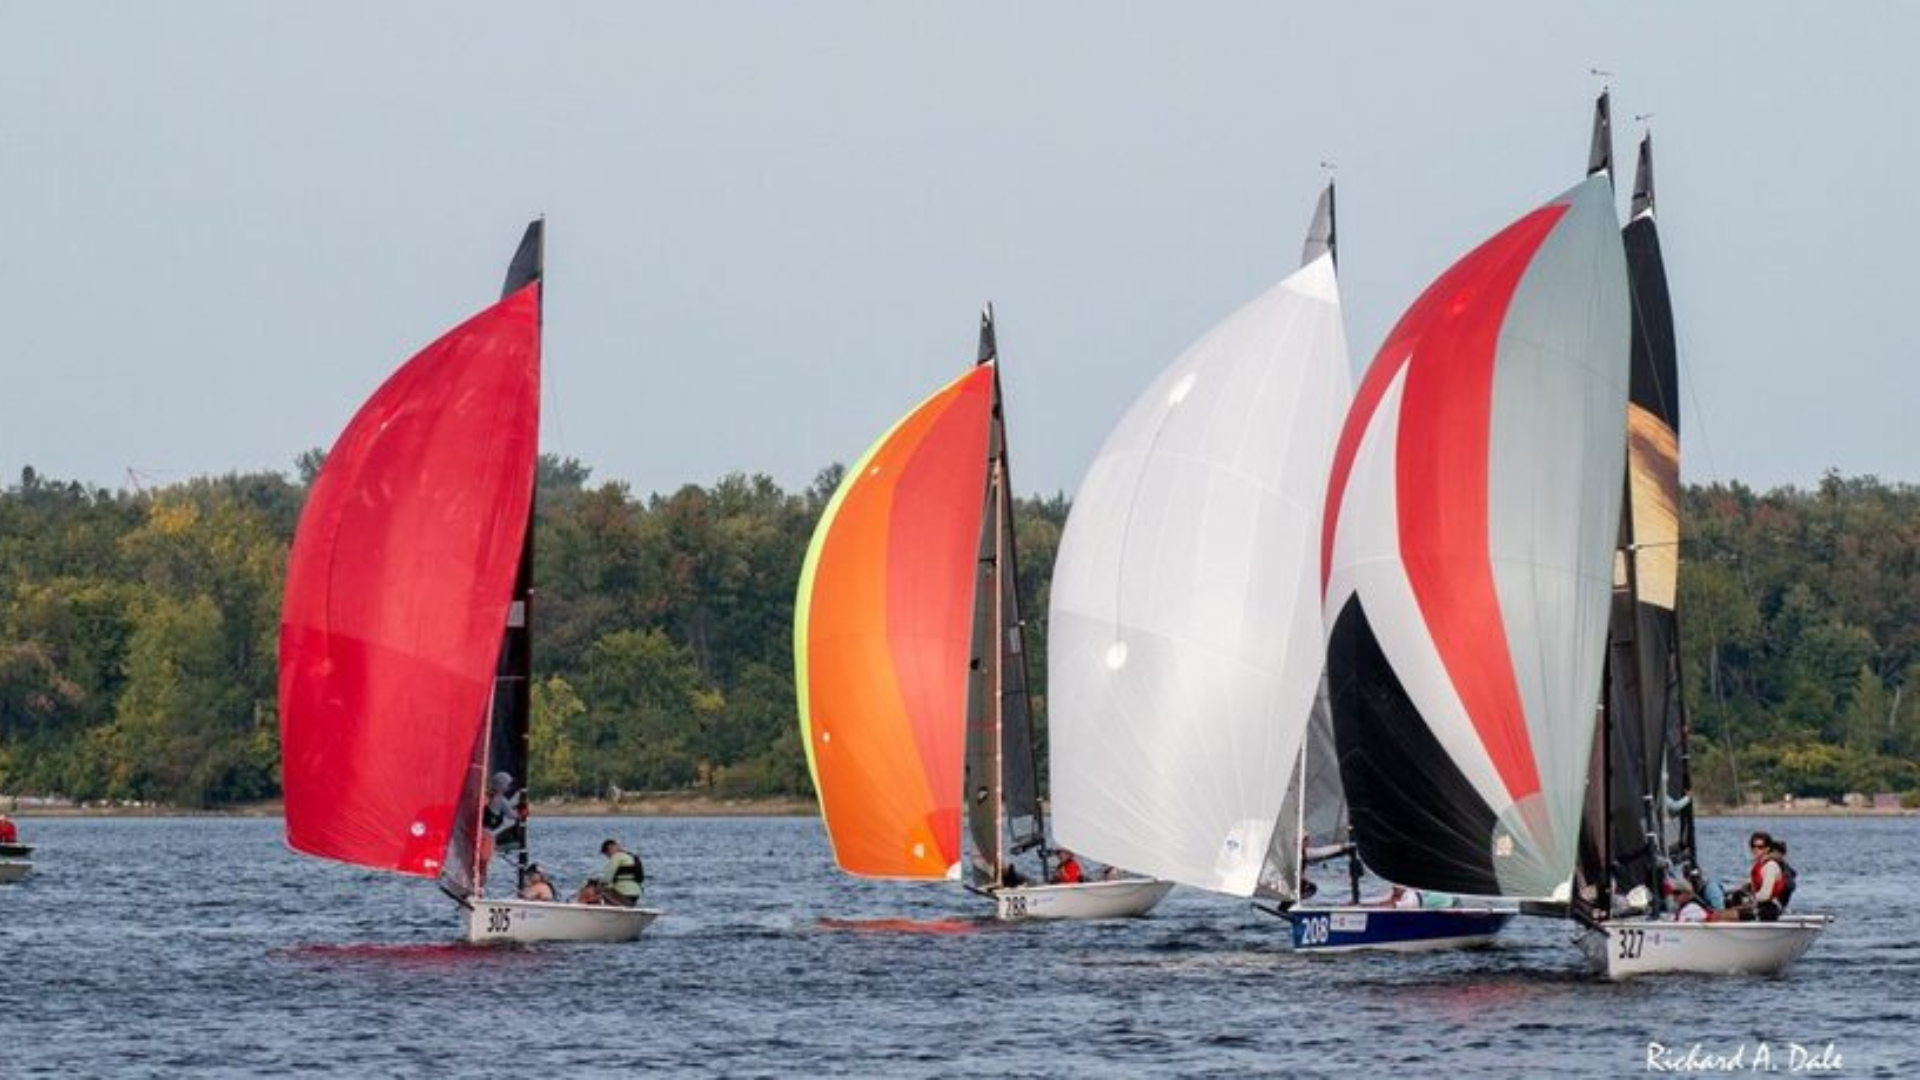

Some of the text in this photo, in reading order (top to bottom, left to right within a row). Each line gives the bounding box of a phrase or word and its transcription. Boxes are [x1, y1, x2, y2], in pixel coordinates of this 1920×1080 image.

[487, 907, 511, 933] 305
[1301, 917, 1329, 945] 208
[1619, 929, 1644, 958] 327
